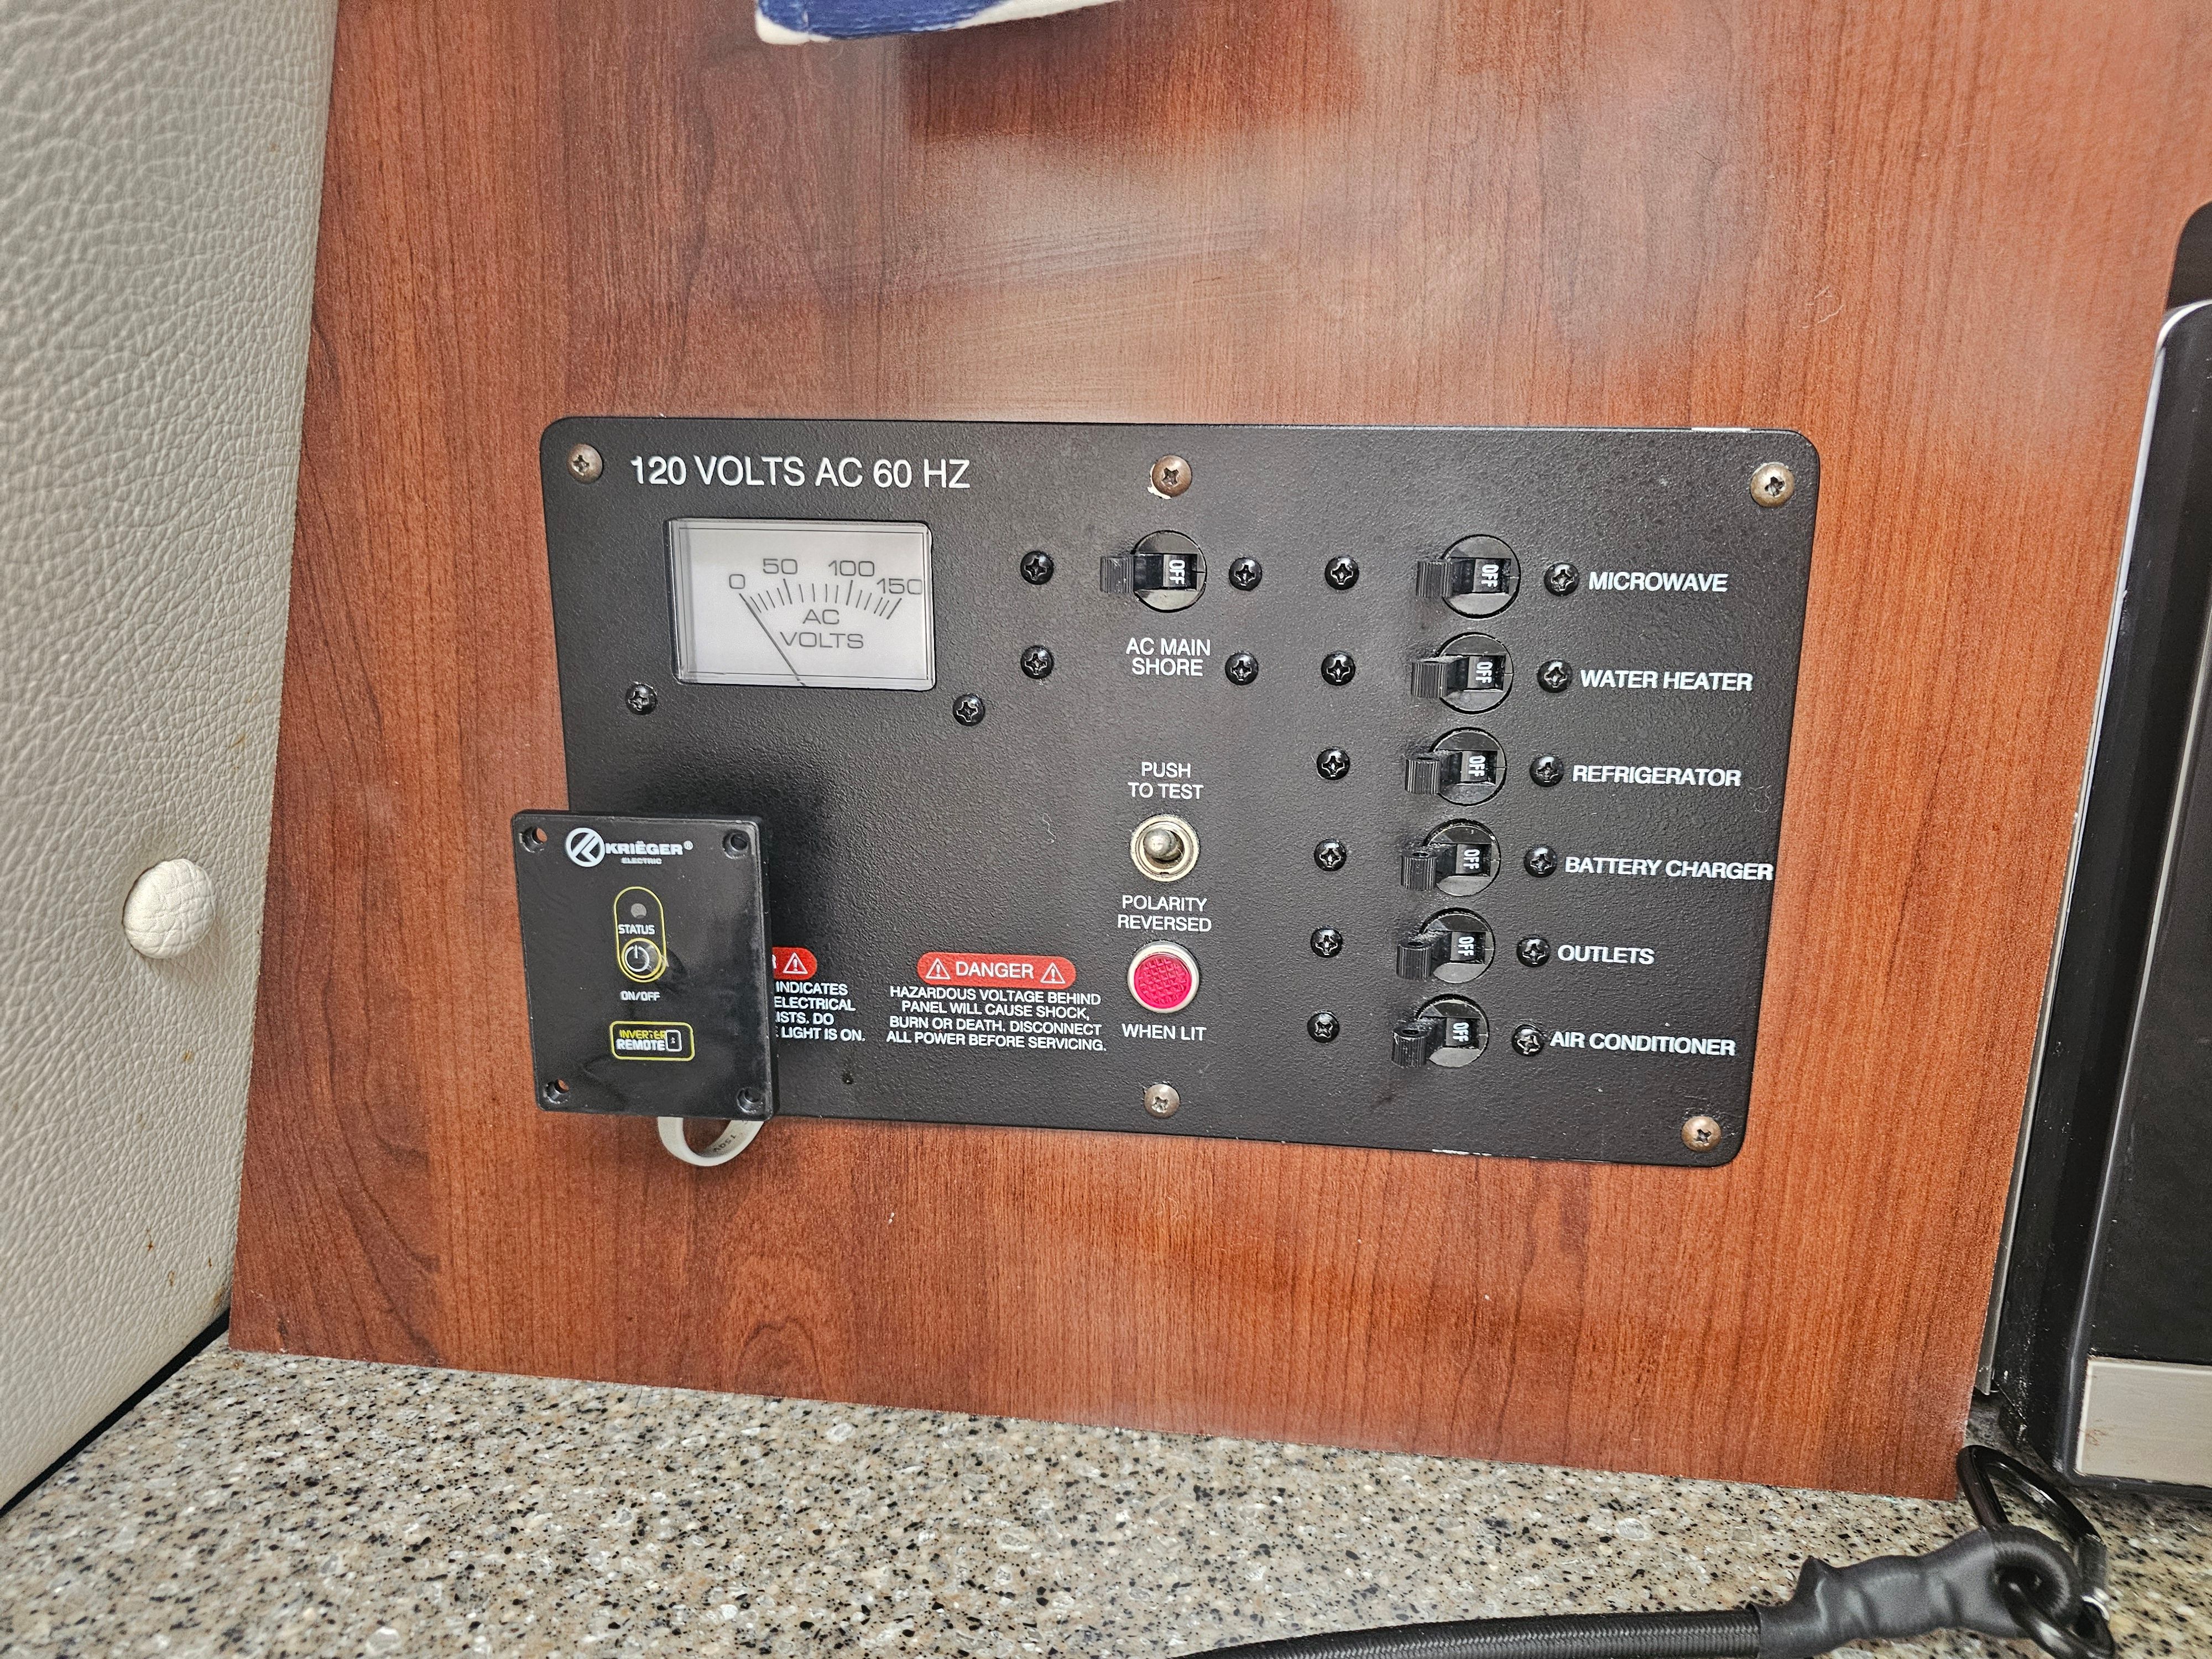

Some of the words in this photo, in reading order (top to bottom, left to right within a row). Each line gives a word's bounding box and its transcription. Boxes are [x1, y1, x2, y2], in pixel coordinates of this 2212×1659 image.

[631, 456, 686, 486] 120
[695, 456, 805, 487] VOLTS
[817, 457, 863, 488] AC
[873, 458, 912, 488] 60
[924, 458, 971, 488] HZ
[762, 558, 798, 575] 50
[828, 560, 875, 577] 100
[1168, 560, 1185, 585] OFF
[728, 573, 745, 589] 0
[1481, 564, 1498, 588] OFF
[1588, 572, 1729, 592] MICROWAVE
[877, 578, 923, 595] 150
[802, 609, 839, 624] AC
[780, 632, 864, 649] VOLTS
[1125, 637, 1155, 655] AC
[1161, 638, 1211, 656] MAIN
[1131, 657, 1203, 676] SHORE
[1476, 661, 1491, 685] OFF
[1580, 670, 1658, 690] WATER
[1663, 671, 1753, 691] HEATER
[1141, 762, 1191, 778] PUSH
[1468, 755, 1486, 778] OFF
[1573, 765, 1741, 786] REFRIGERATOR
[1128, 782, 1154, 798] TO
[1159, 783, 1204, 800] TEST
[620, 857, 662, 865] ELECTRIC
[1463, 848, 1480, 872] OFF
[1565, 856, 1662, 876] BATTERY
[1665, 859, 1774, 881] CHARGER
[1121, 895, 1208, 912] POLARITY
[618, 924, 655, 935] STATUS
[1117, 914, 1212, 932] REVERSED
[1459, 936, 1474, 961] OFF
[1557, 944, 1655, 965] OUTLETS
[956, 961, 1034, 979] DANGER
[620, 990, 660, 1001] ON/OFF
[775, 981, 848, 996] INDICATES
[890, 985, 977, 1001] HAZARDOUS
[979, 990, 1045, 1003] VOLTAGE
[1048, 992, 1102, 1006] BEHIND
[774, 996, 856, 1011] ELECTRICAL
[901, 1000, 948, 1014] PANEL
[950, 1003, 983, 1016] WILL
[984, 1004, 1033, 1018] CAUSE
[1036, 1006, 1091, 1022] SHOCK,
[813, 1013, 834, 1026] DO
[890, 1016, 929, 1029] BURN
[932, 1018, 953, 1031] OR
[956, 1019, 1005, 1033] DEATH.
[1010, 1020, 1102, 1036] DISCONNECT
[781, 1026, 822, 1041] LIGHT
[824, 1028, 838, 1041] IS
[840, 1029, 867, 1042] ON.
[886, 1030, 912, 1044] ALL
[915, 1032, 966, 1046] POWER
[968, 1034, 1025, 1048] BEFORE
[1027, 1036, 1107, 1052] SERVICING.
[1121, 1023, 1176, 1040] WHEN
[1181, 1026, 1207, 1041] LIT
[1453, 1022, 1469, 1042] OFF
[616, 1039, 666, 1051] REMOTE
[1550, 1032, 1585, 1049] AIR
[1589, 1034, 1736, 1056] CONDITIONER
